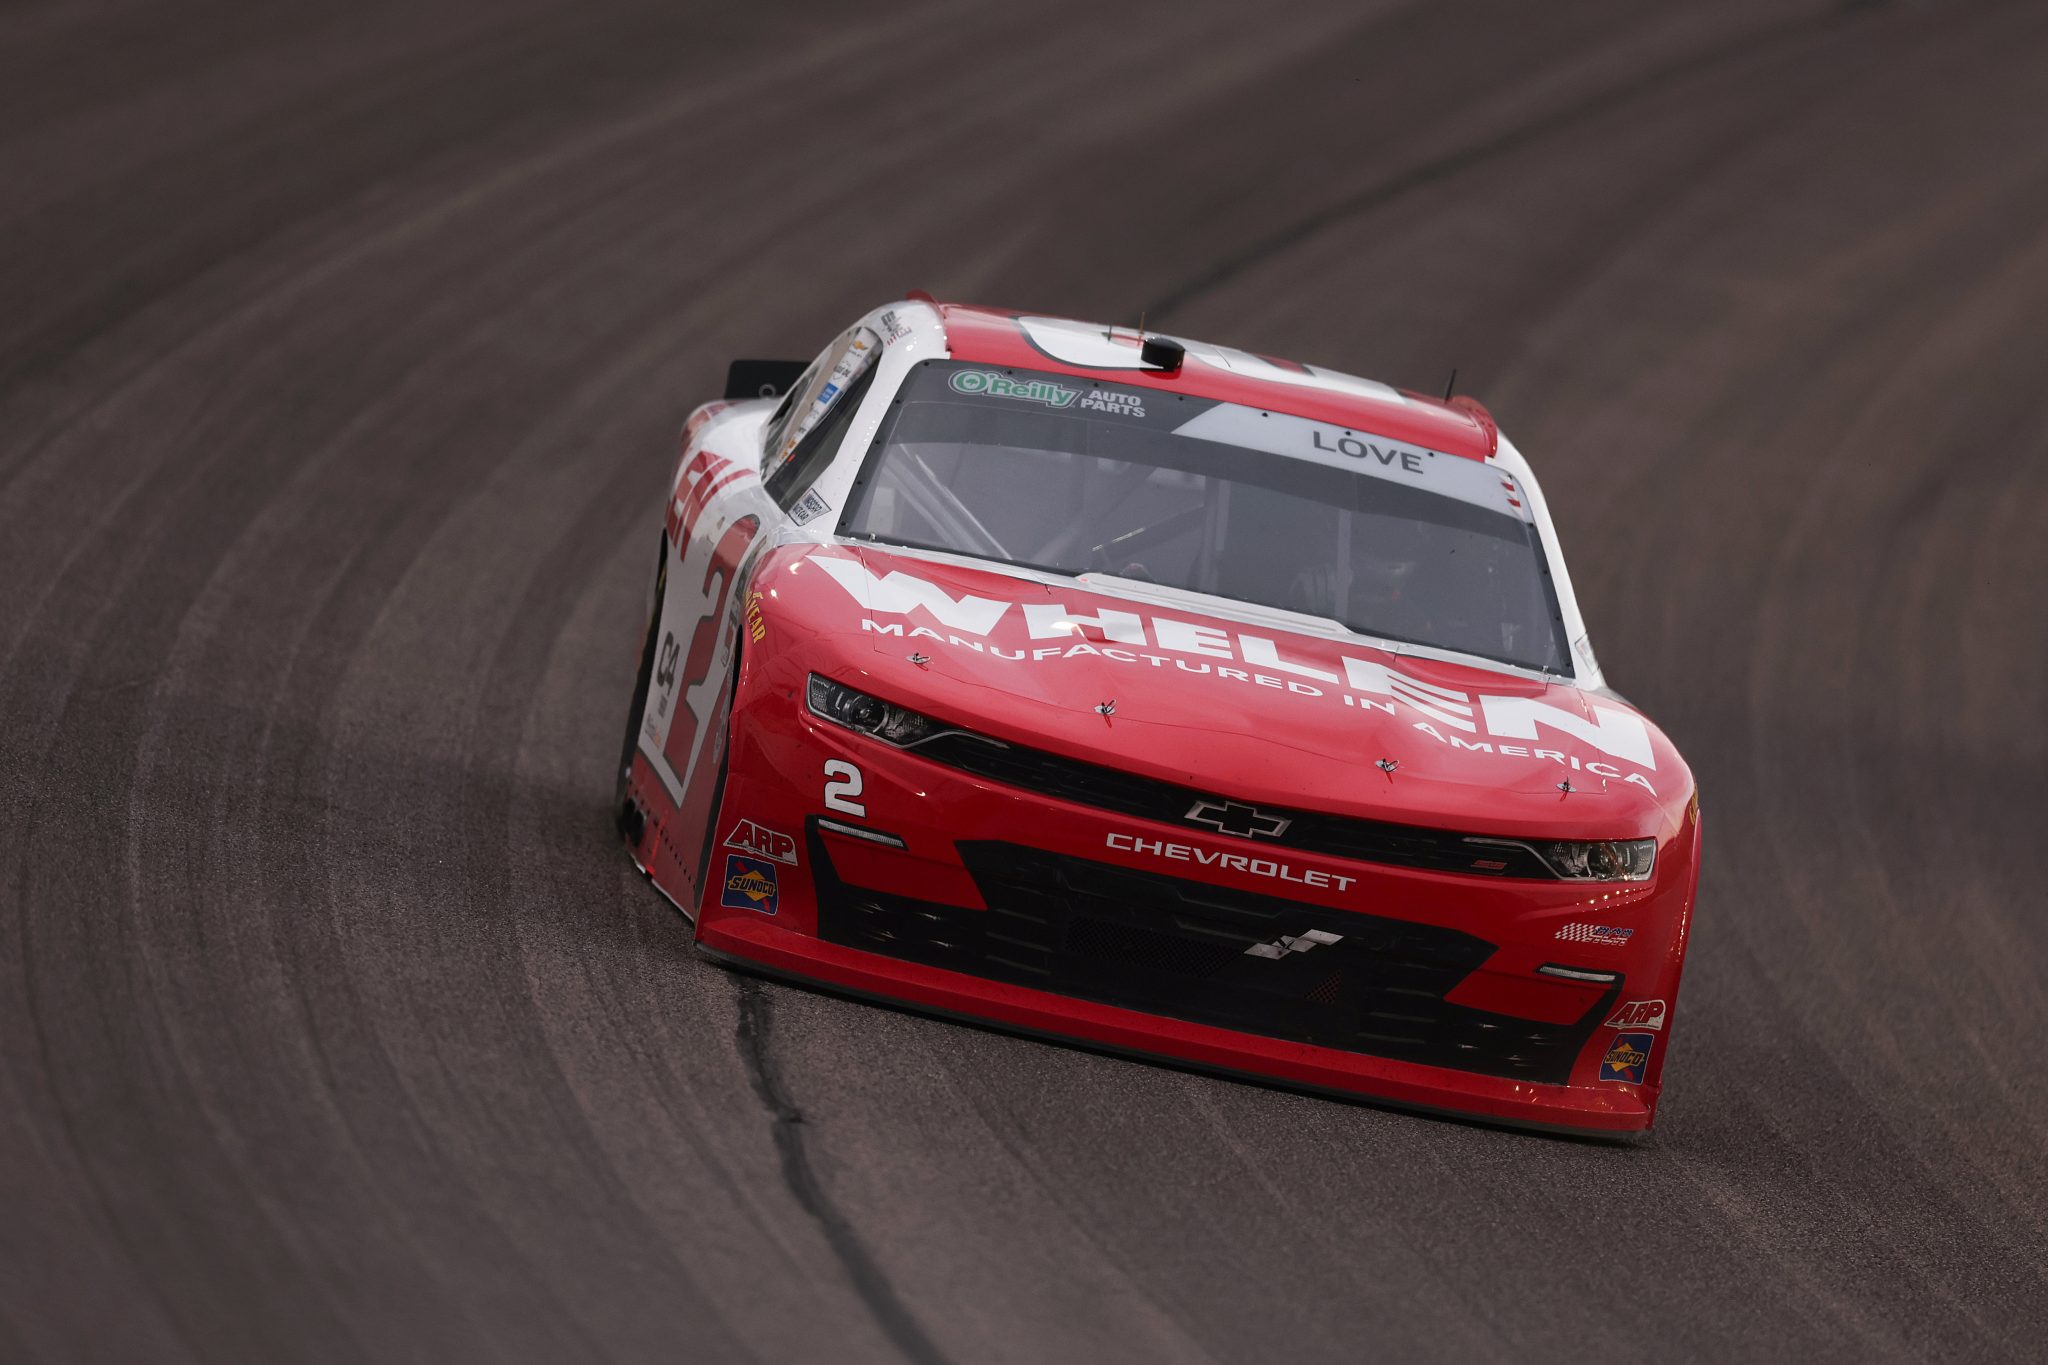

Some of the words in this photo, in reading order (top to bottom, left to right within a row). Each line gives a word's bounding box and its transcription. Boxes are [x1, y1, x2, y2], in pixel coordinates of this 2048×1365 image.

[951, 370, 1079, 407] O'Reilly
[1089, 390, 1142, 406] AUTO
[1080, 398, 1146, 418] PARTS
[1312, 430, 1425, 475] LOVE
[804, 554, 1657, 772] WHELEN
[861, 618, 1325, 697] MANUFACTURED
[1343, 694, 1396, 716] IN
[1412, 721, 1658, 797] AMERICA
[823, 758, 867, 818] 2
[726, 820, 795, 858] ARP
[1105, 832, 1358, 892] CHEVROLET
[729, 877, 775, 896] SUNOCO
[1608, 1000, 1665, 1024] ARP
[1605, 1051, 1644, 1065] SUNOCO
